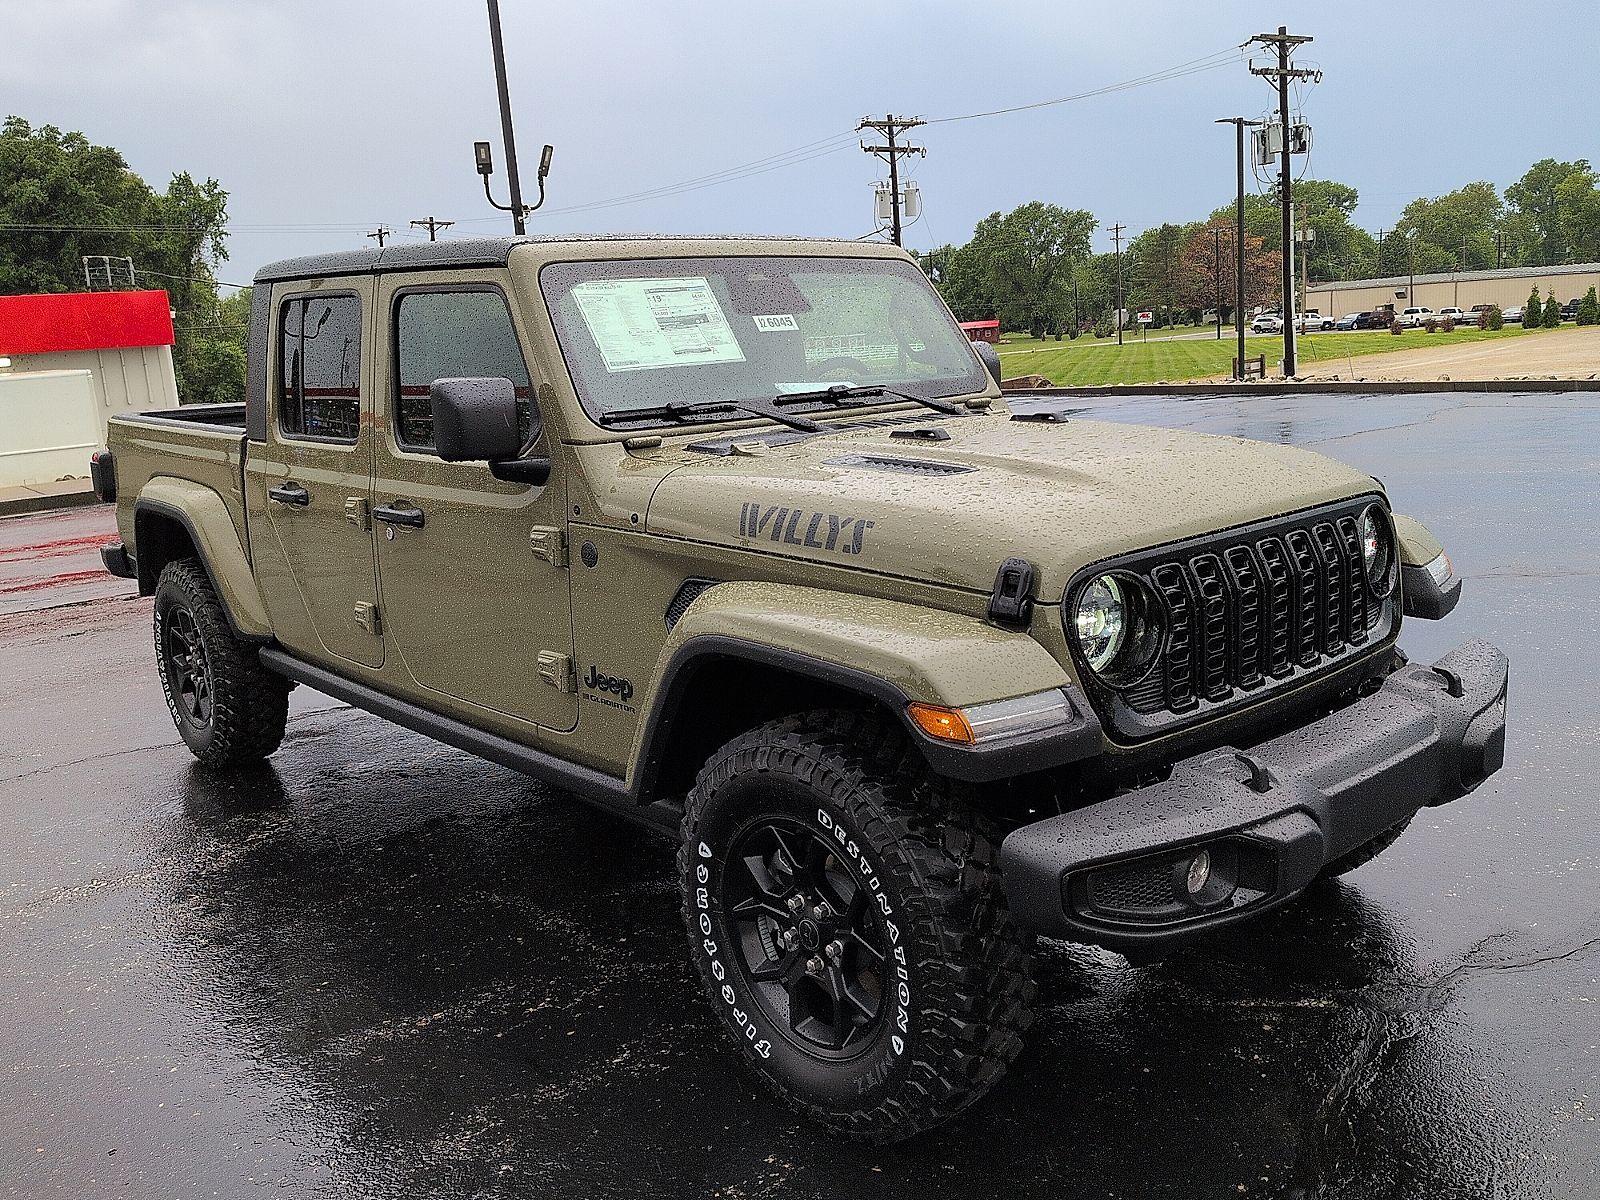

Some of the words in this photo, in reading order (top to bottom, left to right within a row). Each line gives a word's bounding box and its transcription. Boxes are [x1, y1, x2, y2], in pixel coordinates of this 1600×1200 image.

[739, 502, 876, 555] WILLYS
[583, 664, 634, 703] Jeep
[590, 694, 637, 715] GLADIATOR
[817, 808, 910, 1034] DESTINATION
